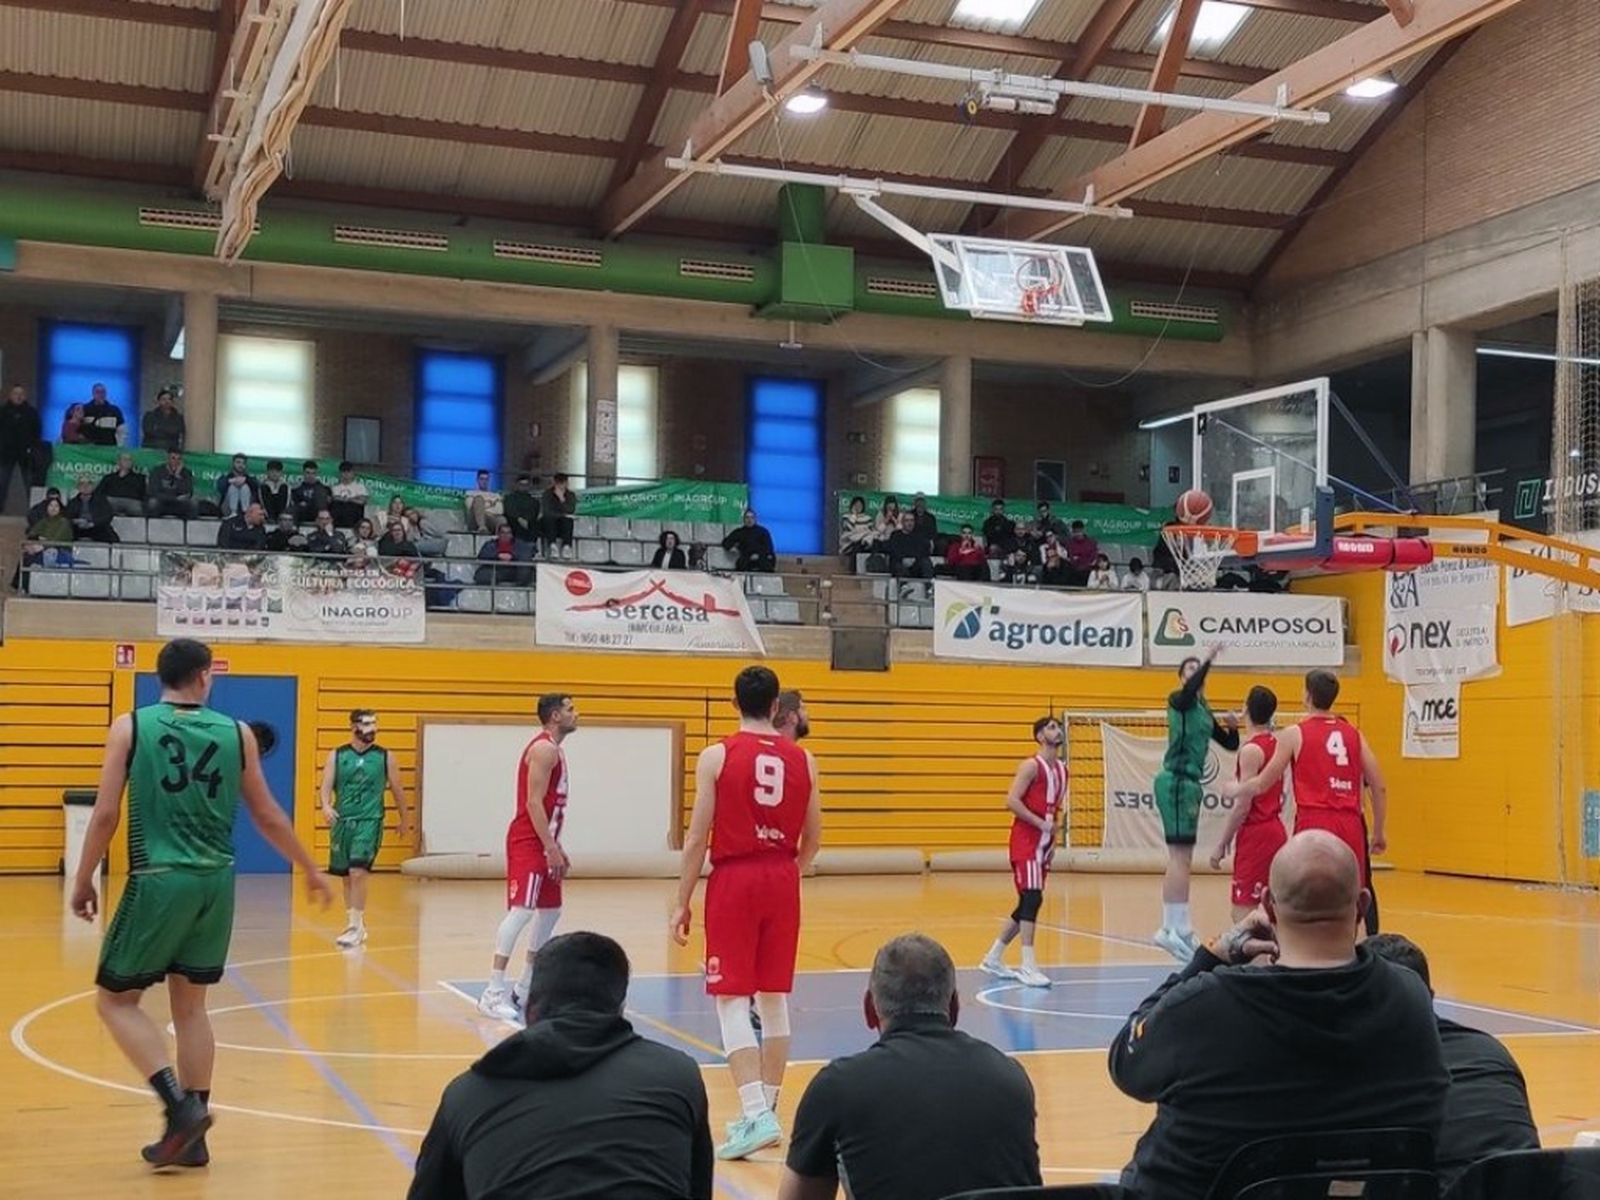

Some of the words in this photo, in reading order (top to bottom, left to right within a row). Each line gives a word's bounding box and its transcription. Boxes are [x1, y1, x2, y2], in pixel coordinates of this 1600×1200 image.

[1542, 472, 1600, 501] IDUS
[322, 605, 413, 619] INAGROUP
[605, 598, 710, 622] Sercasa
[988, 619, 1134, 650] agroclean
[1200, 616, 1337, 634] CAMPOSOL
[1410, 620, 1452, 649] nex
[1326, 730, 1349, 767] 4
[158, 734, 222, 799] 34
[754, 753, 785, 807] 9
